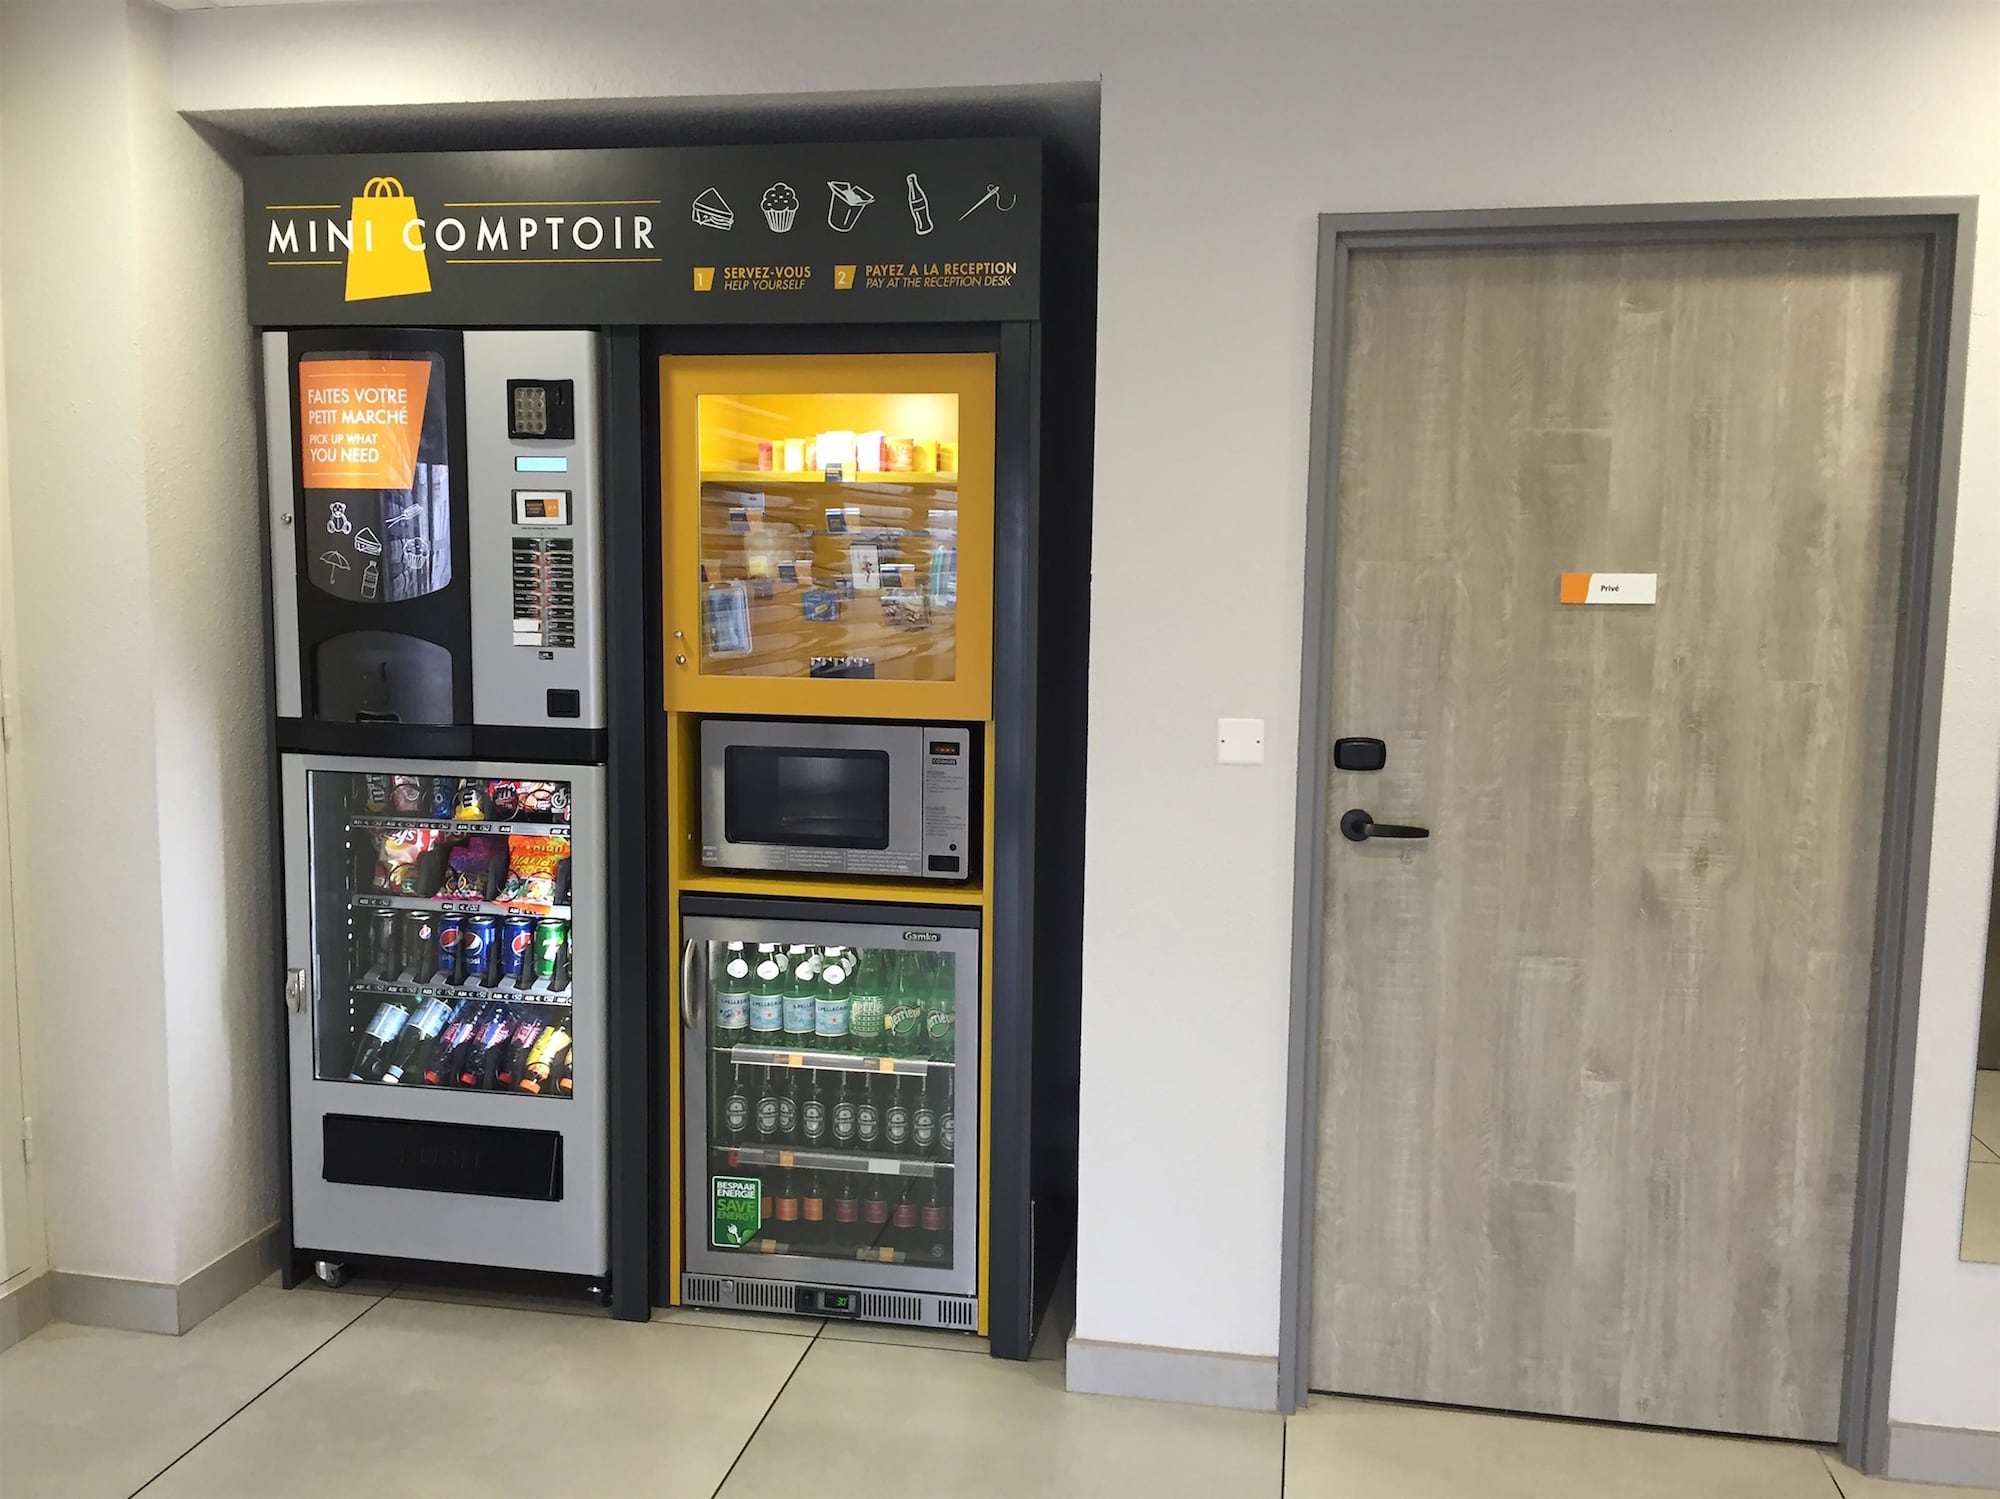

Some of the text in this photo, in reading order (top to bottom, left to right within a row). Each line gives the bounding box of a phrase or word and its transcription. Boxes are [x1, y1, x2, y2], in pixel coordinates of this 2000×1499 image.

[268, 216, 655, 253] MINI COMPTOIR
[723, 266, 811, 279] SERVEZ-VOUS
[865, 262, 1017, 276] PAYEZ A LA RECEPTION
[837, 271, 846, 285] 2
[865, 275, 1012, 288] PAY AT THE RECEPTION DESK
[724, 279, 806, 291] HELP YOURSELF
[308, 388, 407, 405] FAITES VOTRE
[309, 406, 408, 425] PETIT MARCHÉ
[309, 433, 377, 445] PICK UP WHAT
[310, 448, 380, 463] YOU NEED
[1600, 584, 1620, 592] Privé
[904, 931, 938, 941] Gamko
[717, 1181, 756, 1191] BESPAAR
[716, 1189, 756, 1199] ENERGIE
[717, 1199, 756, 1214] SAVE
[717, 1211, 756, 1221] ENERGY
